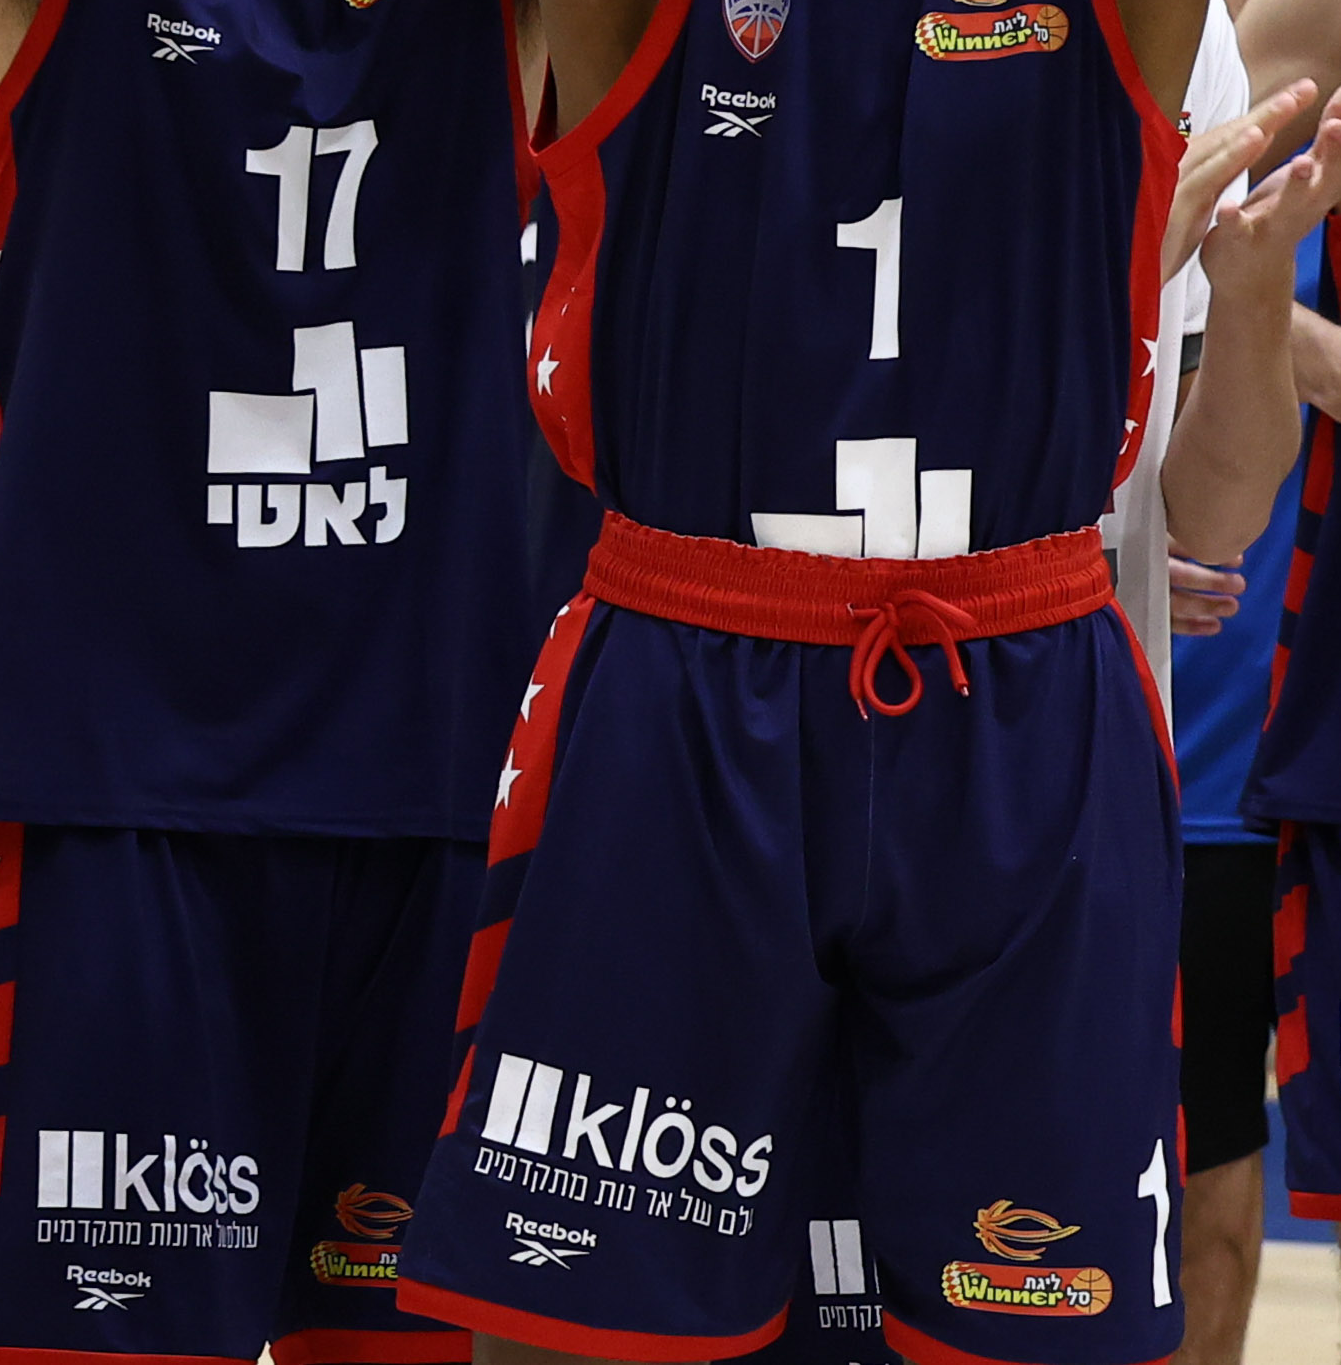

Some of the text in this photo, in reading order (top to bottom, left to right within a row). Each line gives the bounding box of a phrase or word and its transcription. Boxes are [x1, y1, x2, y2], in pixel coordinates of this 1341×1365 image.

[146, 12, 222, 45] Reebok
[933, 25, 1032, 51] Winner
[993, 11, 1028, 34] ליגת
[701, 83, 776, 109] Reebok
[245, 119, 379, 272] 17
[836, 195, 903, 360] 1
[206, 466, 408, 549] לאטי
[562, 1073, 774, 1197] klöss
[114, 1132, 260, 1214] klöss
[474, 1146, 589, 1202] מתקדמים
[678, 1188, 712, 1227] של
[1137, 1138, 1173, 1308] 1
[37, 1219, 142, 1247] מתקדמים
[148, 1222, 213, 1248] ארונות
[505, 1212, 597, 1247] Reebok
[66, 1264, 152, 1288] Reebok
[960, 1273, 1064, 1306] Winner
[1024, 1273, 1061, 1291] ליגת
[1066, 1286, 1091, 1306] סל
